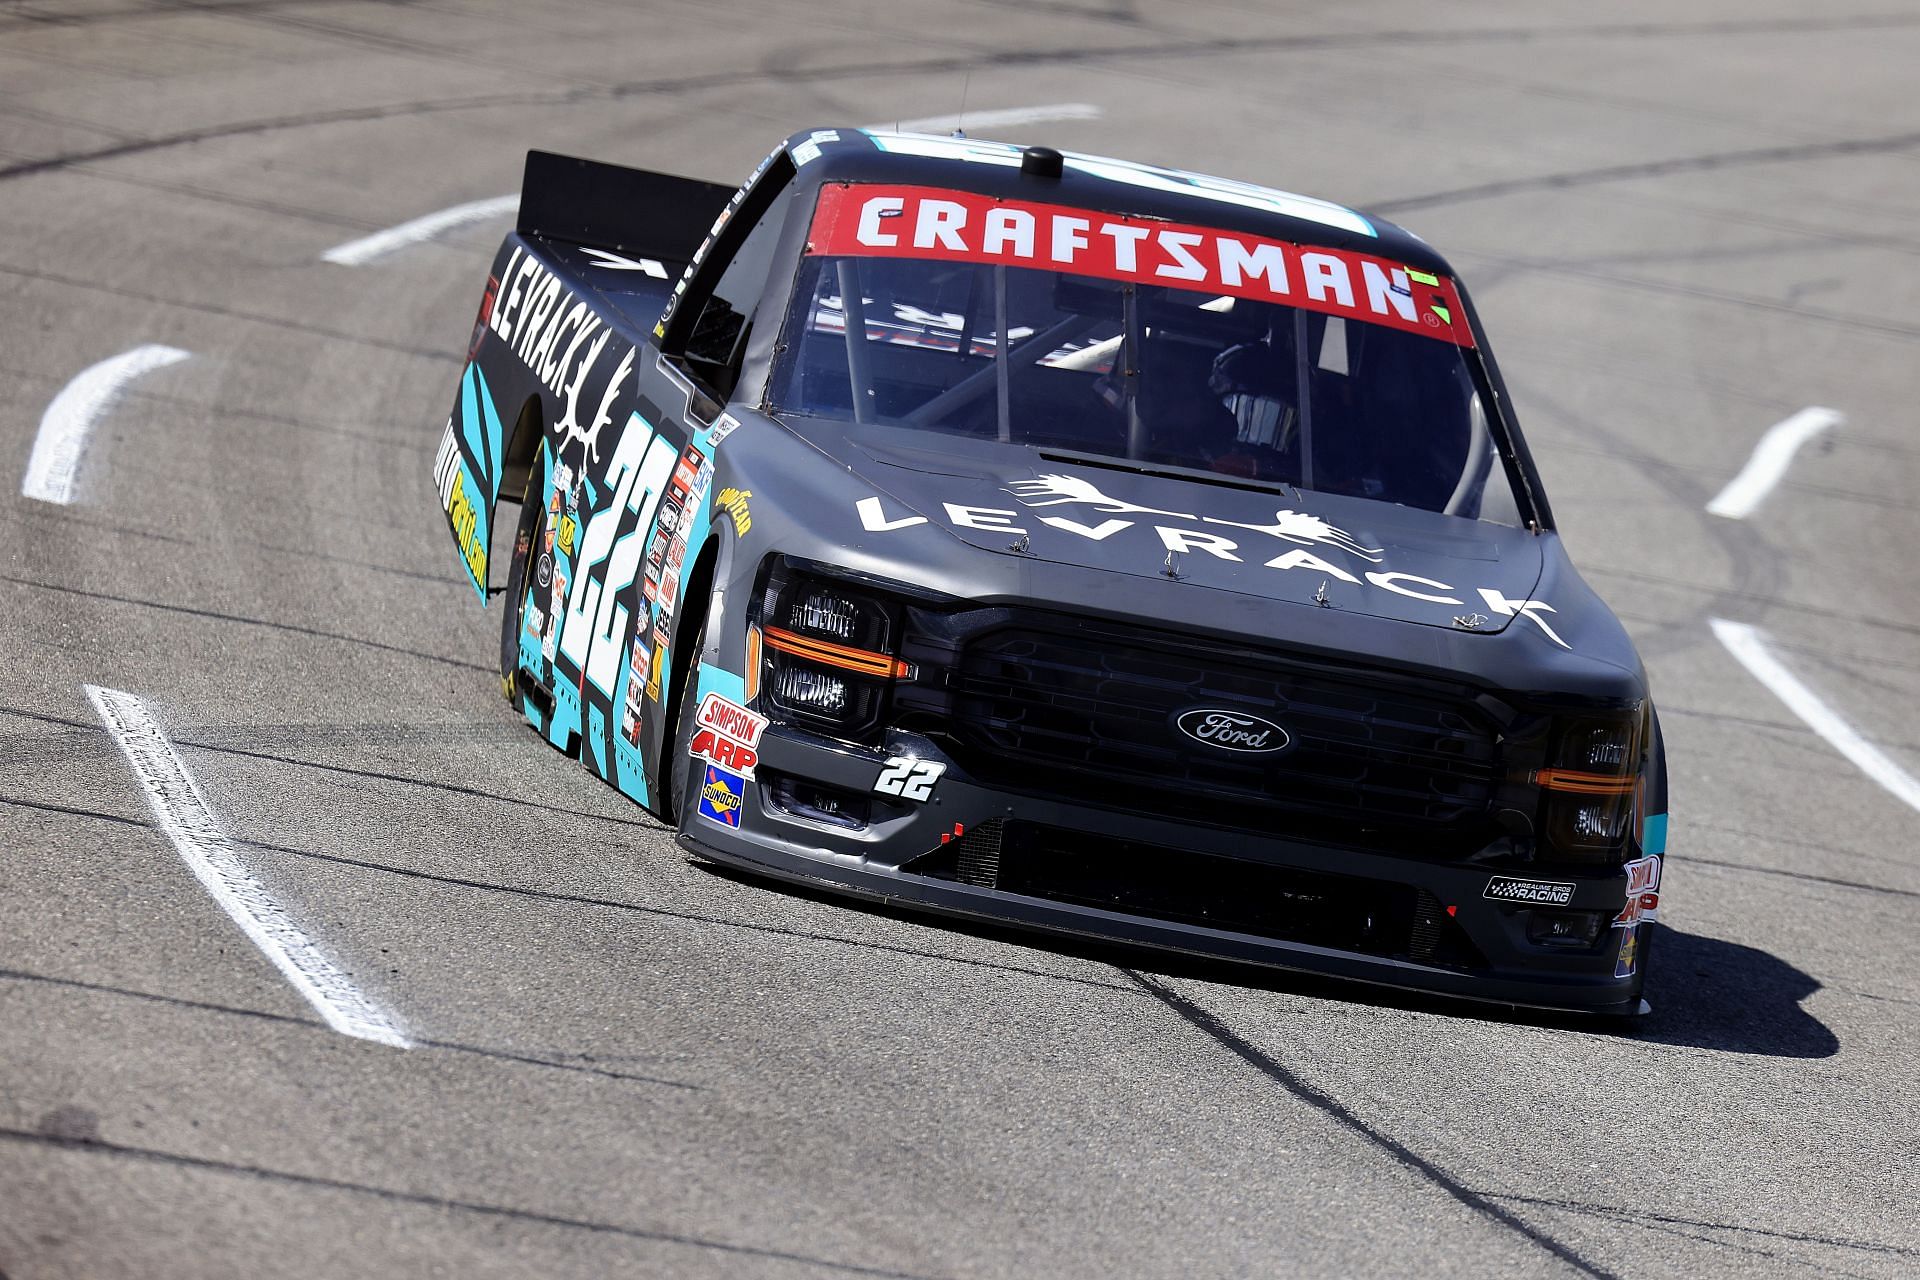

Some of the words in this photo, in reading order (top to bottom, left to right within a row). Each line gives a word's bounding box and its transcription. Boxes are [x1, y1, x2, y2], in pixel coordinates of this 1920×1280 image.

[857, 197, 1419, 323] CRAFTSMAN
[489, 245, 602, 398] LEVRACK
[714, 487, 753, 539] GOODYEAR
[560, 410, 679, 702] 22
[855, 495, 1573, 650] LEVRACK
[704, 700, 761, 742] SIMPSON
[1197, 714, 1272, 750] Ford
[690, 729, 758, 772] ARP
[704, 785, 740, 809] SUNOCO
[873, 756, 948, 802] 22
[1516, 888, 1570, 903] RACING
